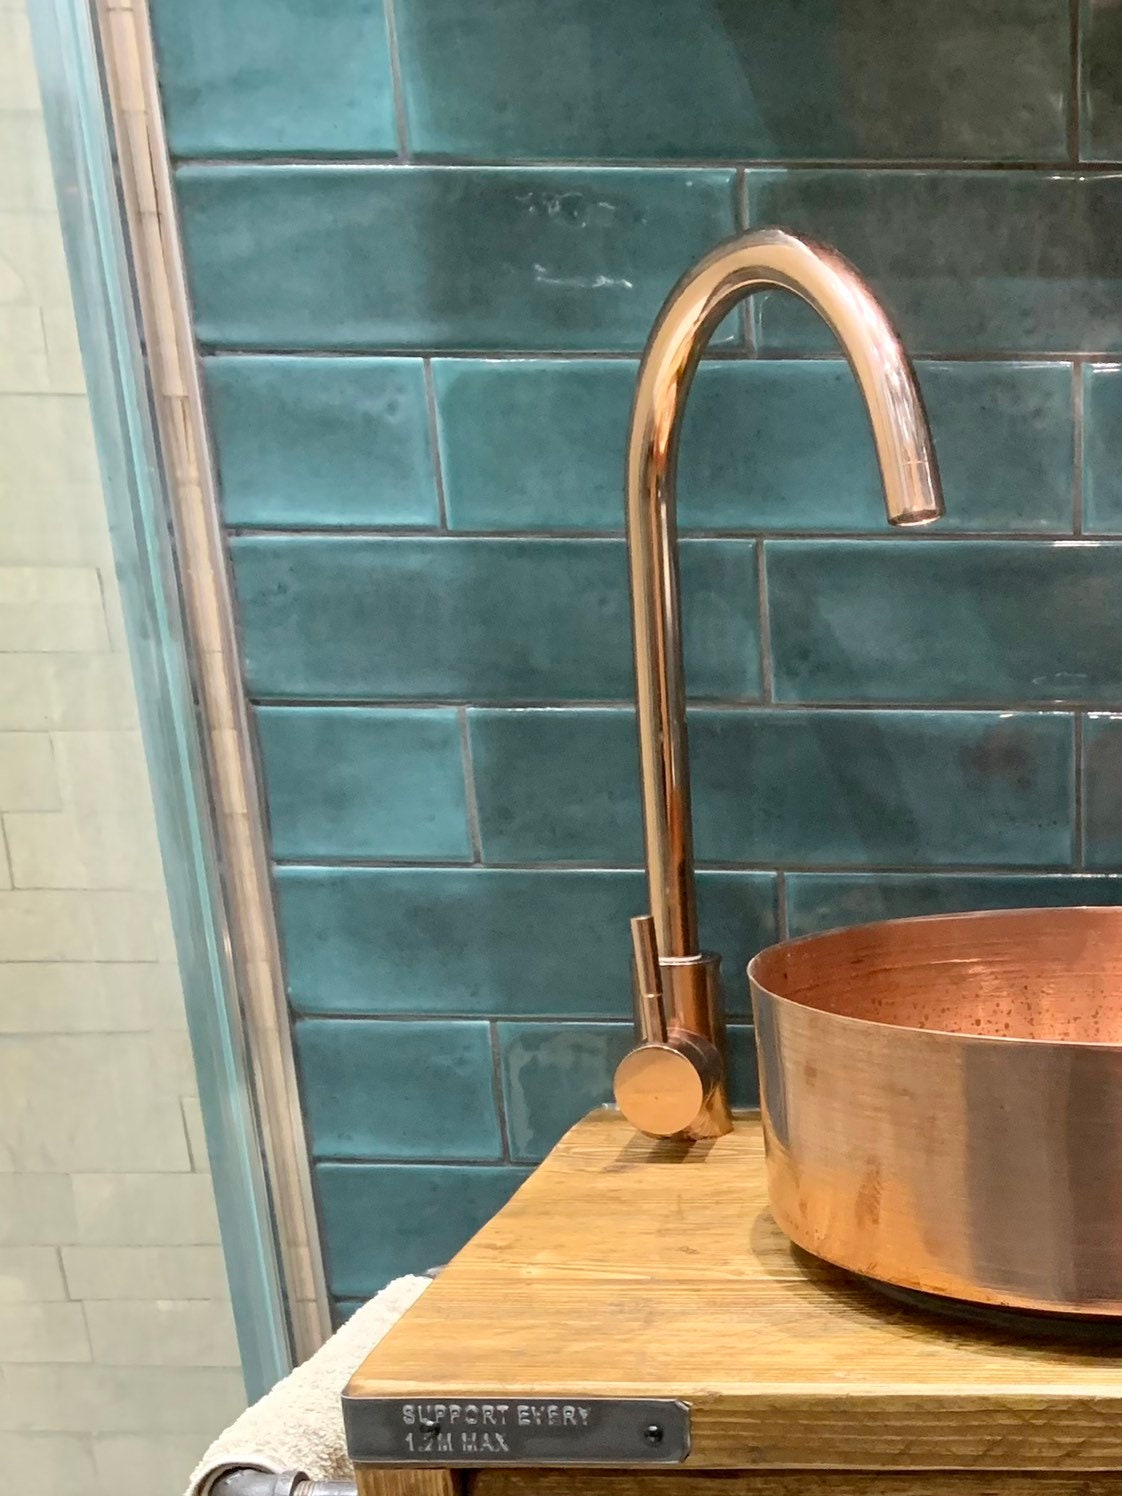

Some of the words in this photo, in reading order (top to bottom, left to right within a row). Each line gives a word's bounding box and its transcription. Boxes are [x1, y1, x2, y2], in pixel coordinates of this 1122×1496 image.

[402, 1404, 509, 1425] SUPPORT
[517, 1405, 591, 1426] EVERY
[461, 1432, 510, 1452] MAX
